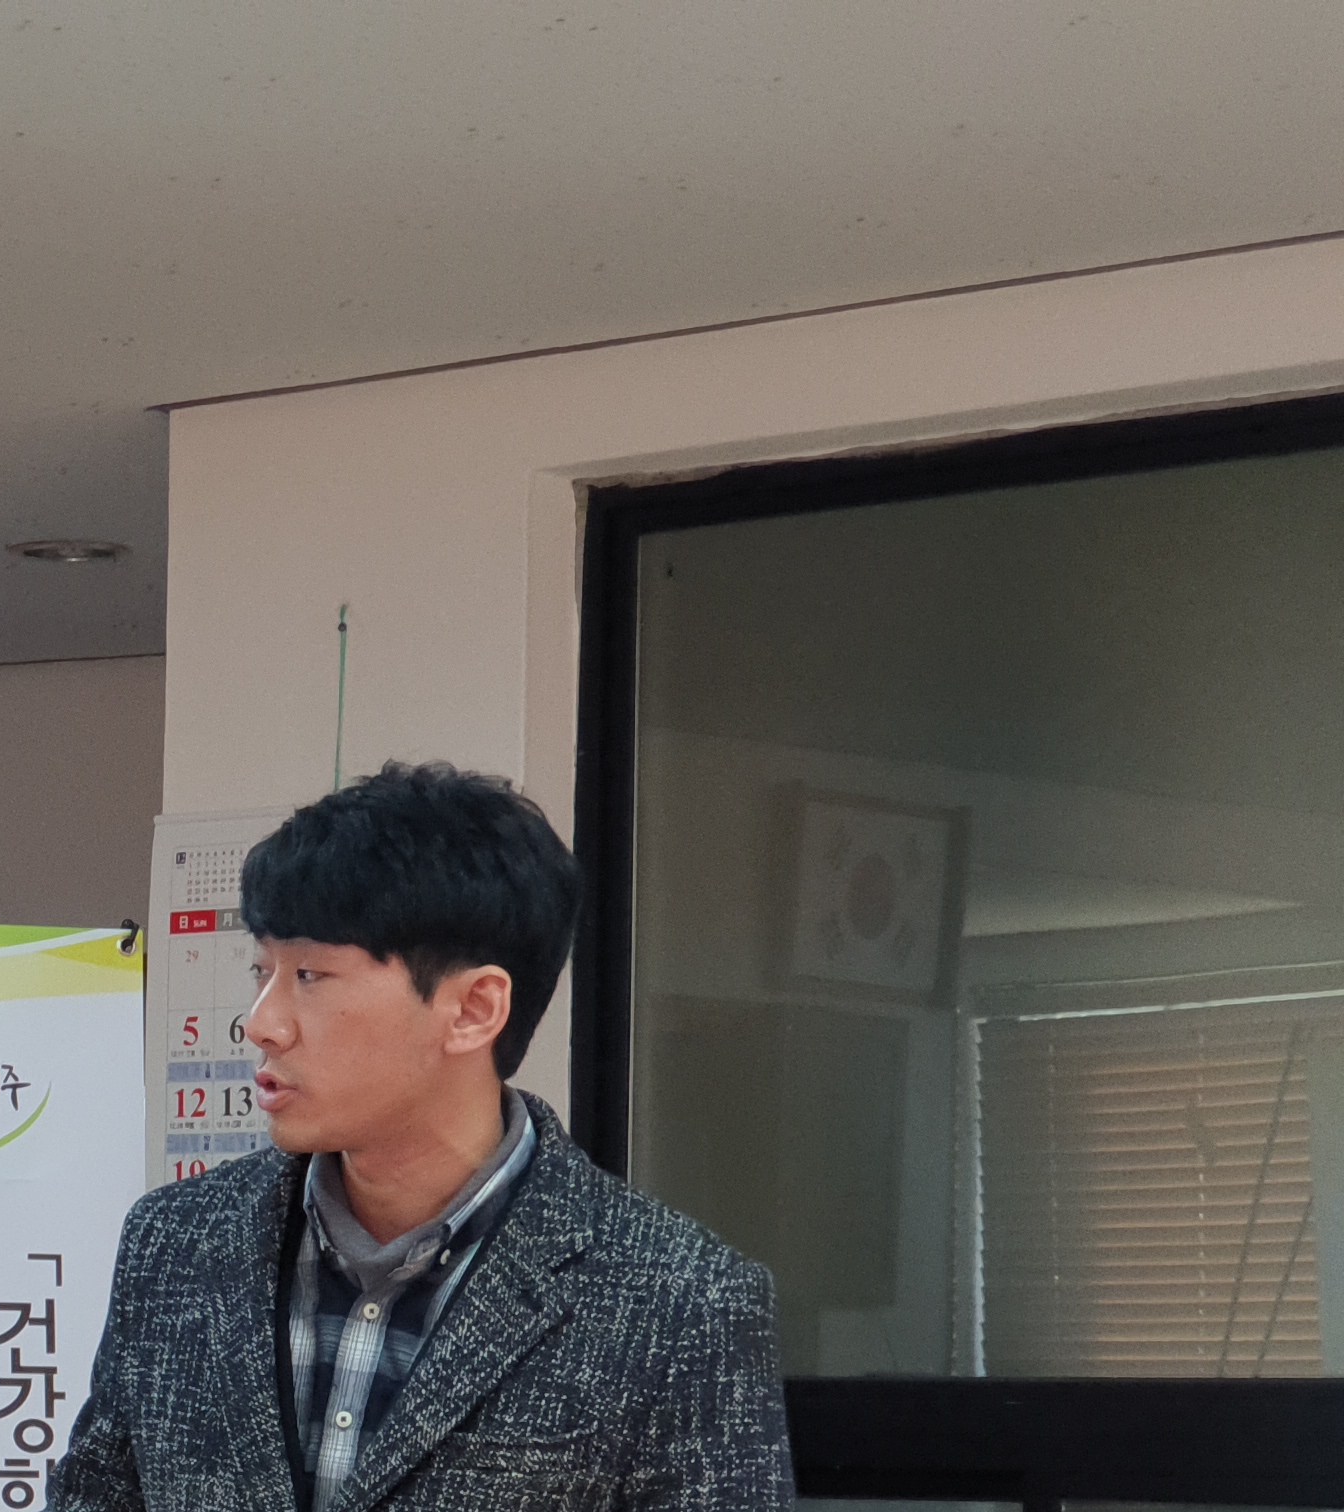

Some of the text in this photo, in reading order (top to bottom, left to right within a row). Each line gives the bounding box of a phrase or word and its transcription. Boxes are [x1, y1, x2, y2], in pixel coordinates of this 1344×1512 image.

[183, 1016, 199, 1046] 5
[229, 1013, 245, 1044] 6
[175, 1088, 206, 1118] 12
[221, 1086, 253, 1117] 13
